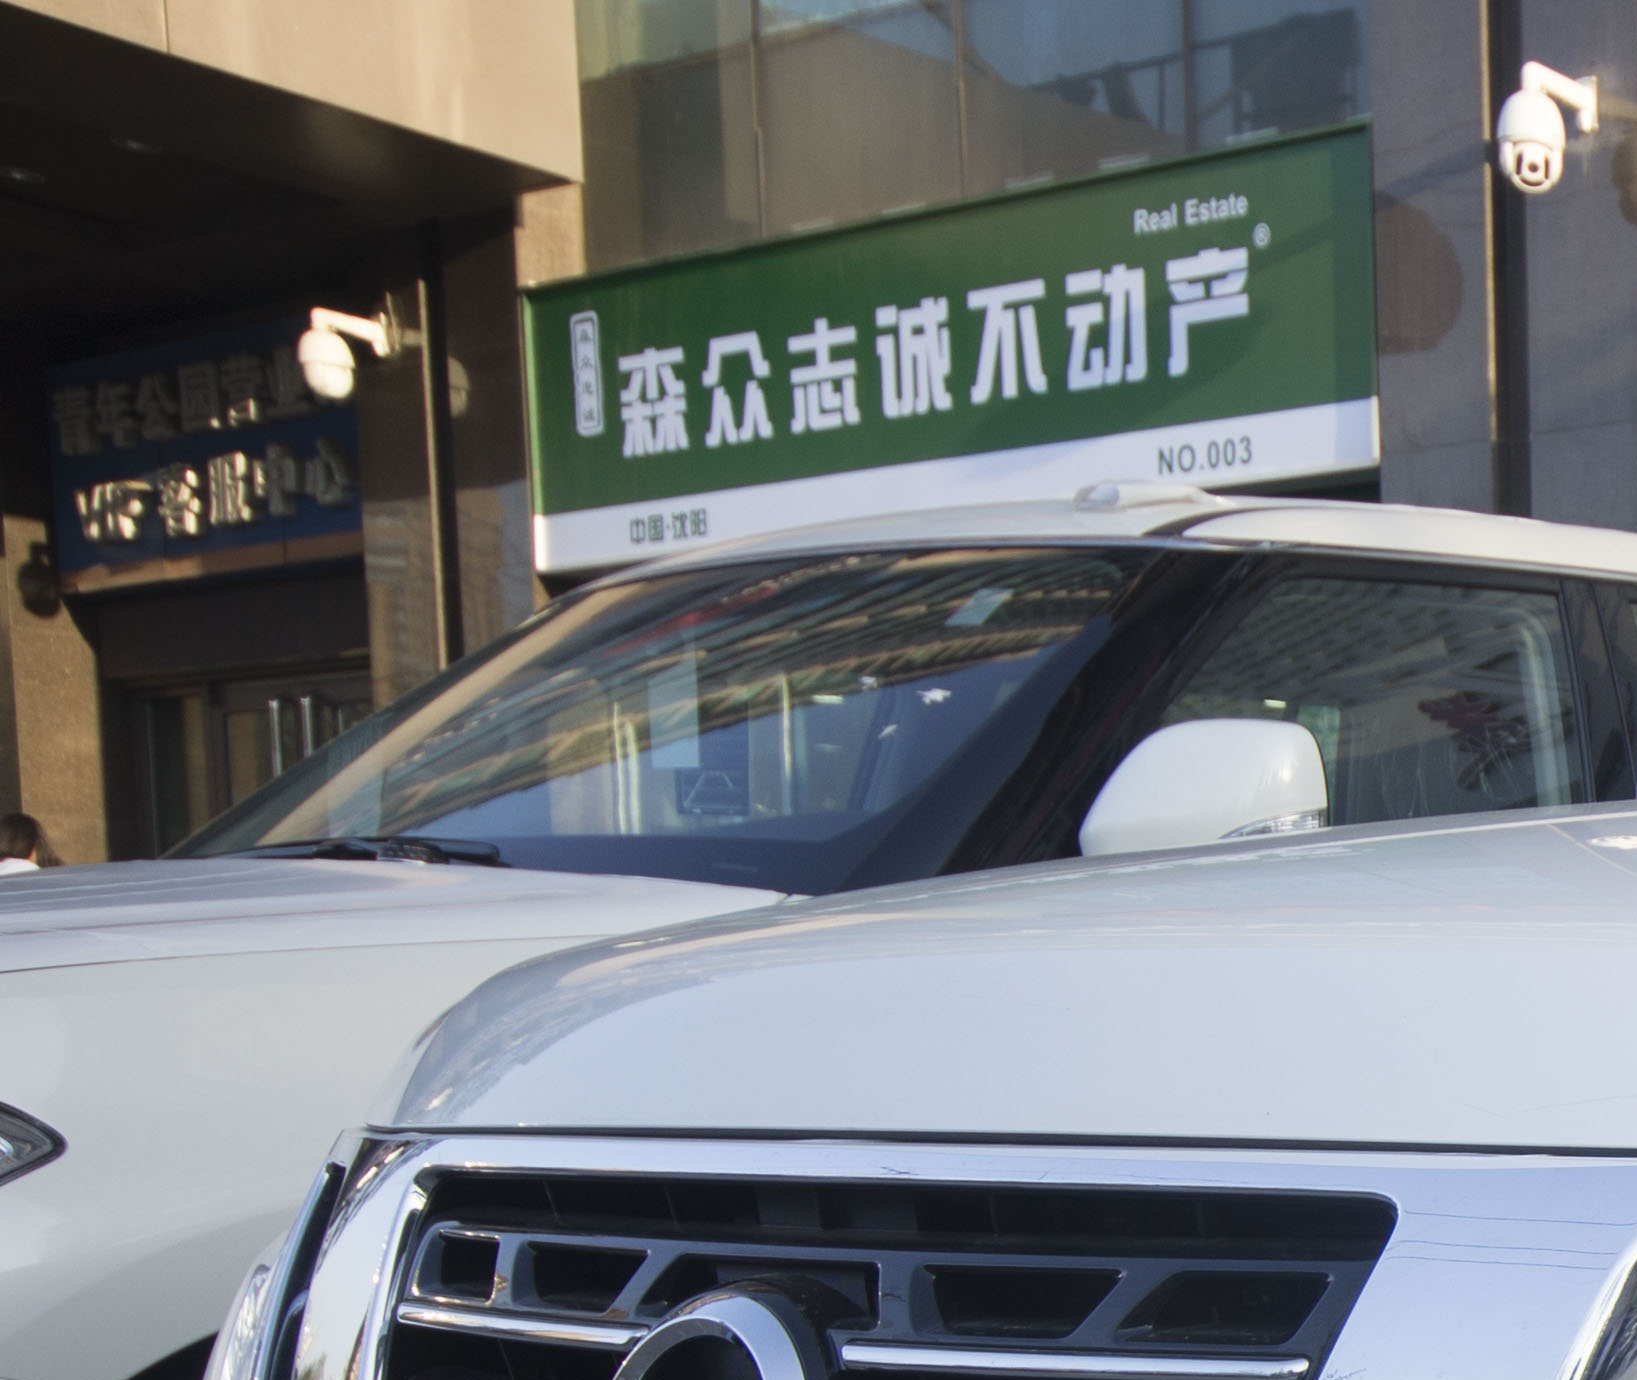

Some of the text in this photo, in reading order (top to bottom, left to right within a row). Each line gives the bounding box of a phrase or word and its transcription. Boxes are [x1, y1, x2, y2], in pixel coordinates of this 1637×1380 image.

[1133, 192, 1249, 235] Real Estate
[618, 247, 1250, 459] 森众志诚不动产
[1157, 434, 1253, 476] NO.003
